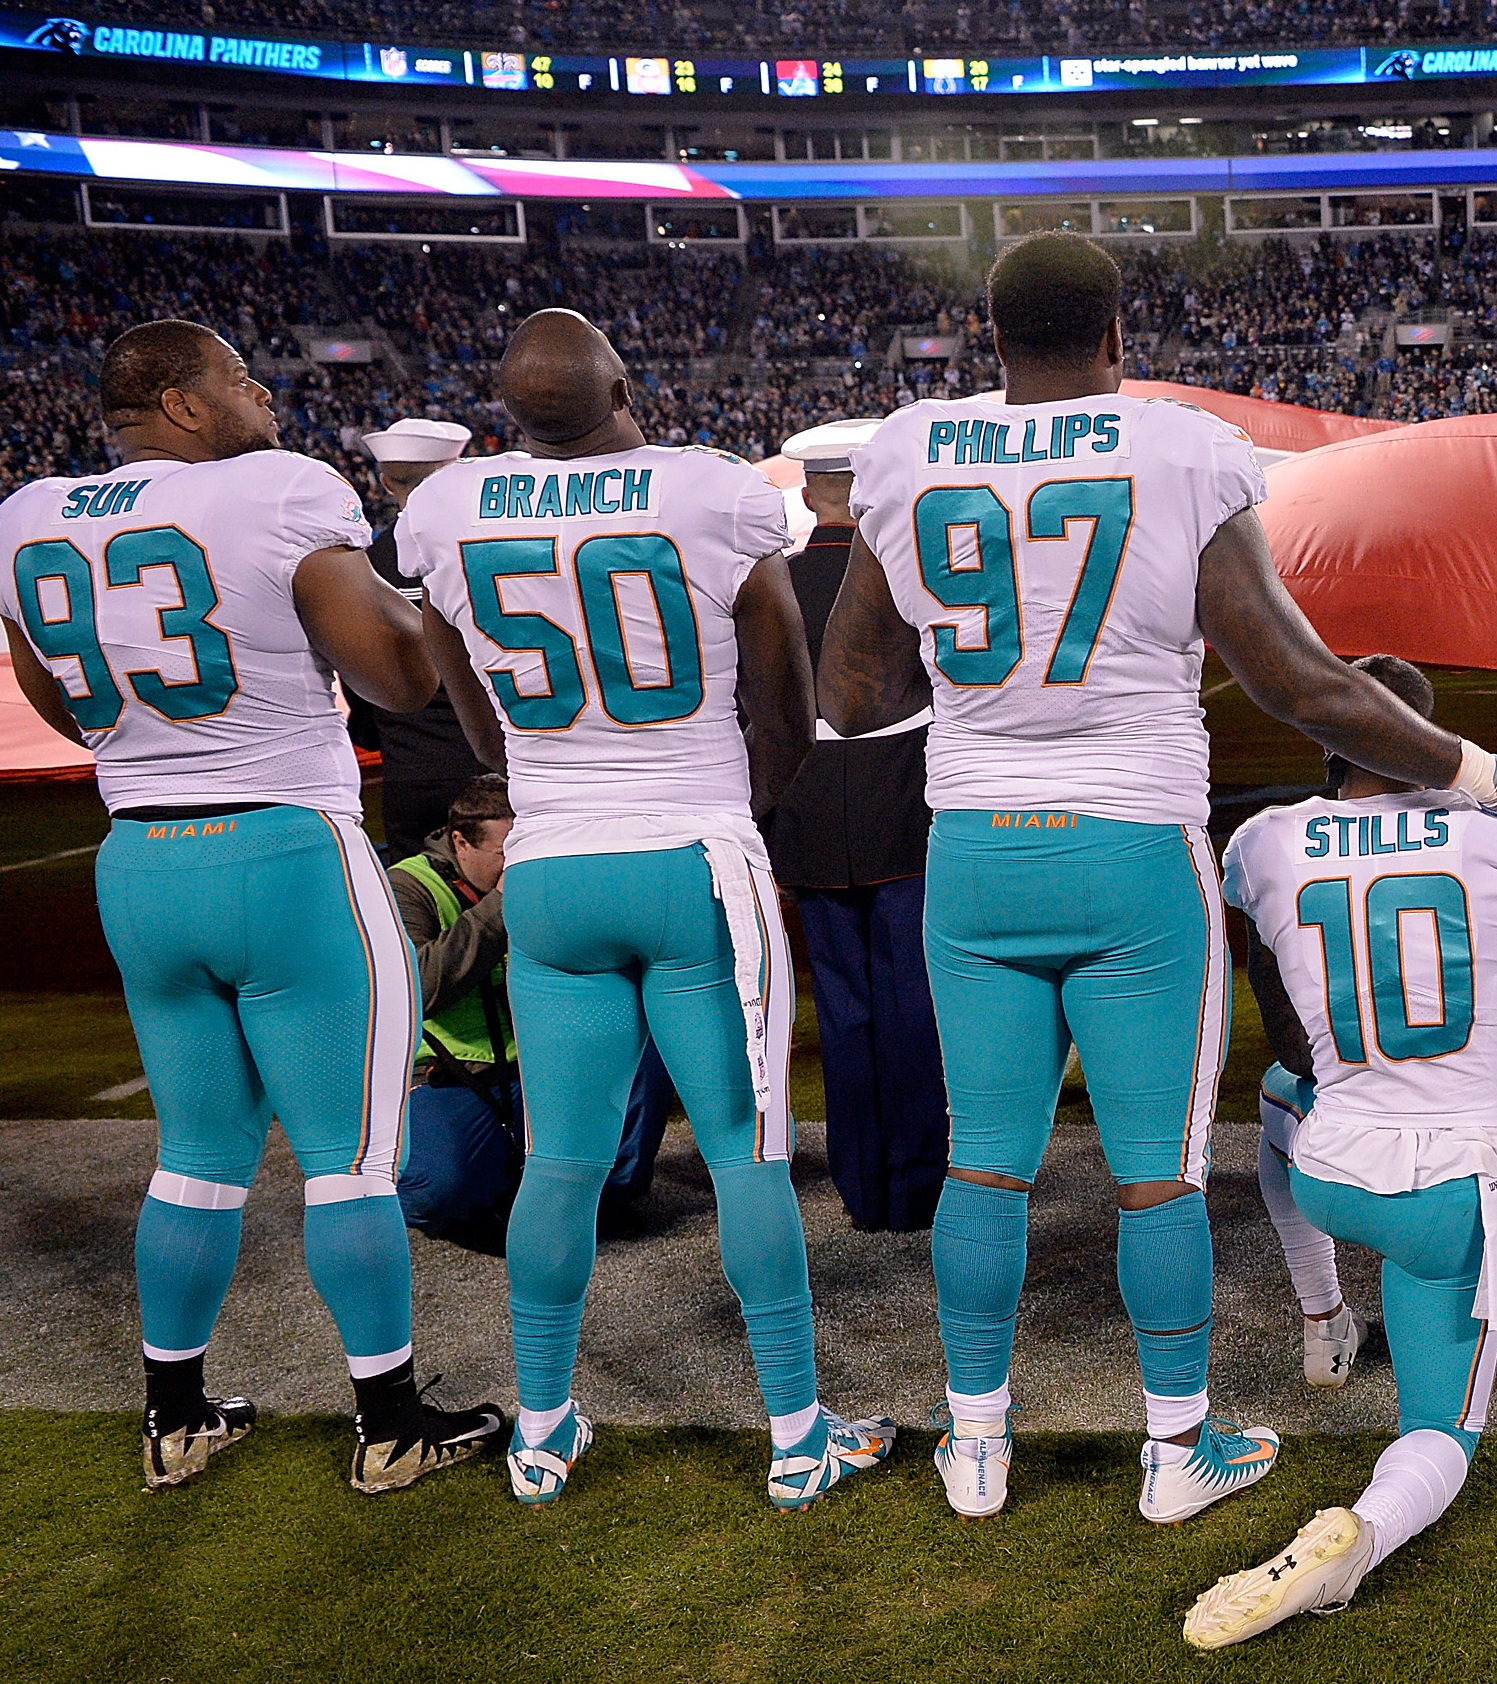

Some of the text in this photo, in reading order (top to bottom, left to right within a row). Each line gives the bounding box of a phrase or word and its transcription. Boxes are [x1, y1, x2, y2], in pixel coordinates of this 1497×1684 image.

[93, 26, 322, 71] CAROLINA PANTHERS
[531, 56, 551, 72] 47
[533, 73, 554, 89] 10
[578, 74, 592, 90] F
[720, 77, 733, 94] F
[866, 77, 879, 93] F
[1012, 74, 1024, 90] F
[928, 413, 1121, 464] PHILLIPS
[61, 478, 152, 519] SUH
[479, 469, 652, 519] BRANCH
[912, 474, 1135, 688] 97
[13, 522, 241, 732] 93
[457, 531, 706, 732] 50
[146, 820, 236, 839] MIAMI
[991, 813, 1077, 828] MIAMI
[1305, 808, 1449, 857] STILLS
[1295, 871, 1477, 1066] 10
